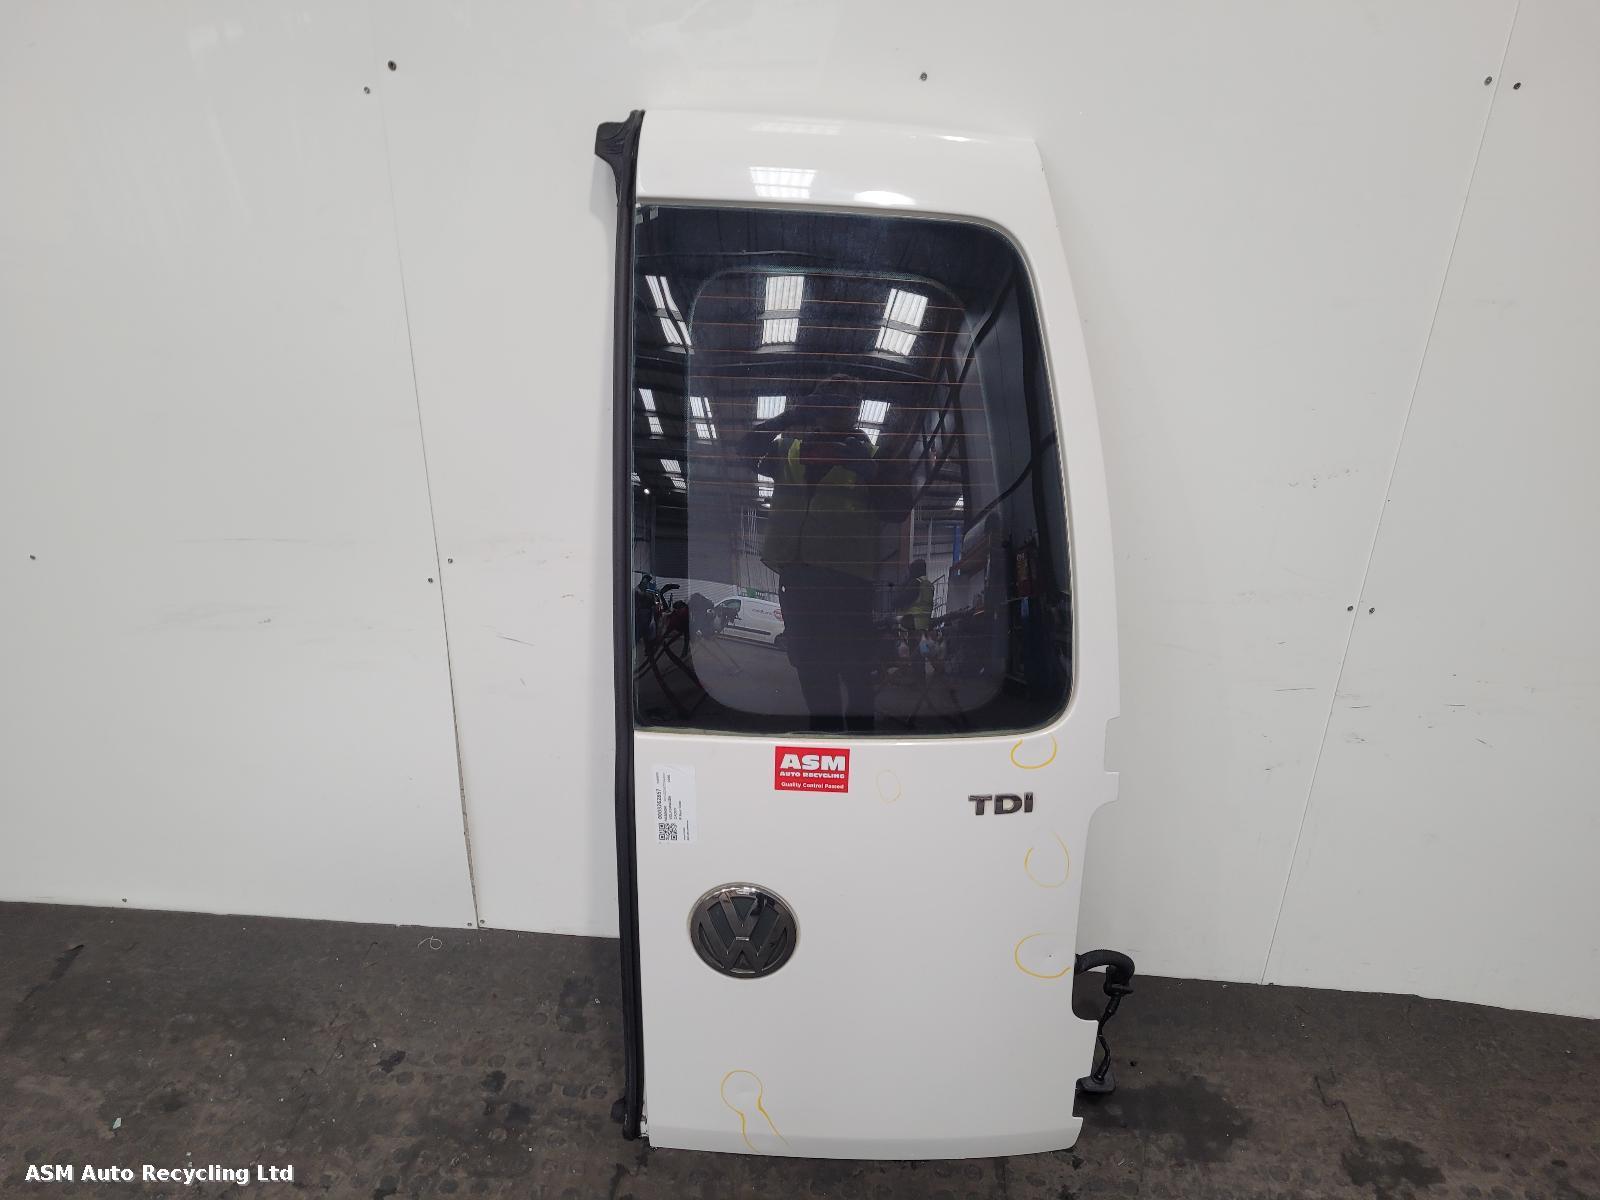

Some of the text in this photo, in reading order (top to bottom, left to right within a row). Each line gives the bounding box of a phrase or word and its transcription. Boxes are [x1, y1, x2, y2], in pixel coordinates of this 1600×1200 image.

[780, 753, 846, 771] ASM
[781, 781, 801, 789] Quality
[968, 792, 1034, 816] TDI
